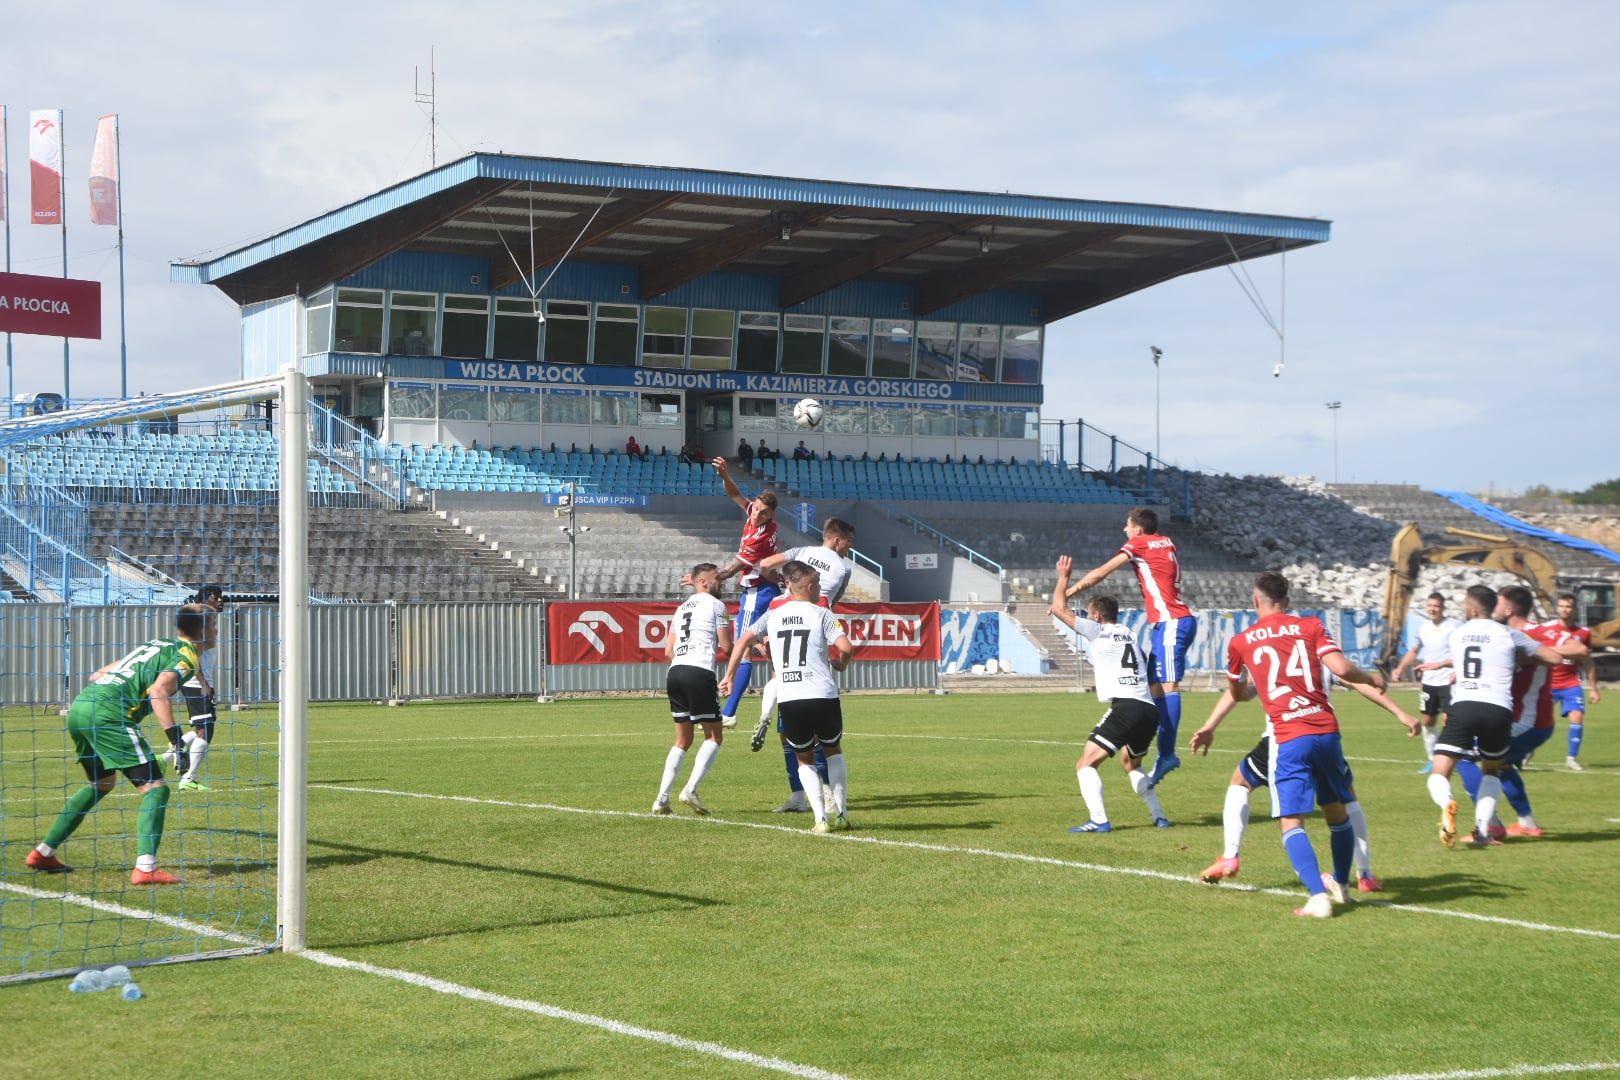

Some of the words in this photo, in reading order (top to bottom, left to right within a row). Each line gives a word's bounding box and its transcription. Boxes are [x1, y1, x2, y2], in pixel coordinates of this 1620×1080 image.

[13, 296, 71, 315] PŁOCKA
[460, 361, 521, 380] WISŁA
[526, 365, 586, 383] PŁOCK
[634, 370, 711, 389] STADION
[716, 374, 741, 390] im.
[746, 375, 850, 395] KAZIMIERZA
[853, 379, 952, 399] GÓRSKIEGO
[596, 496, 609, 504] VIP
[614, 496, 635, 505] PZPN
[680, 611, 693, 643] 3
[782, 615, 804, 626] MIKITA
[1245, 624, 1301, 645] KOLAR
[777, 629, 811, 668] 77
[1121, 643, 1139, 675] 4
[1252, 639, 1316, 701] 24
[1463, 645, 1482, 679] 6
[783, 671, 802, 682] DBK
